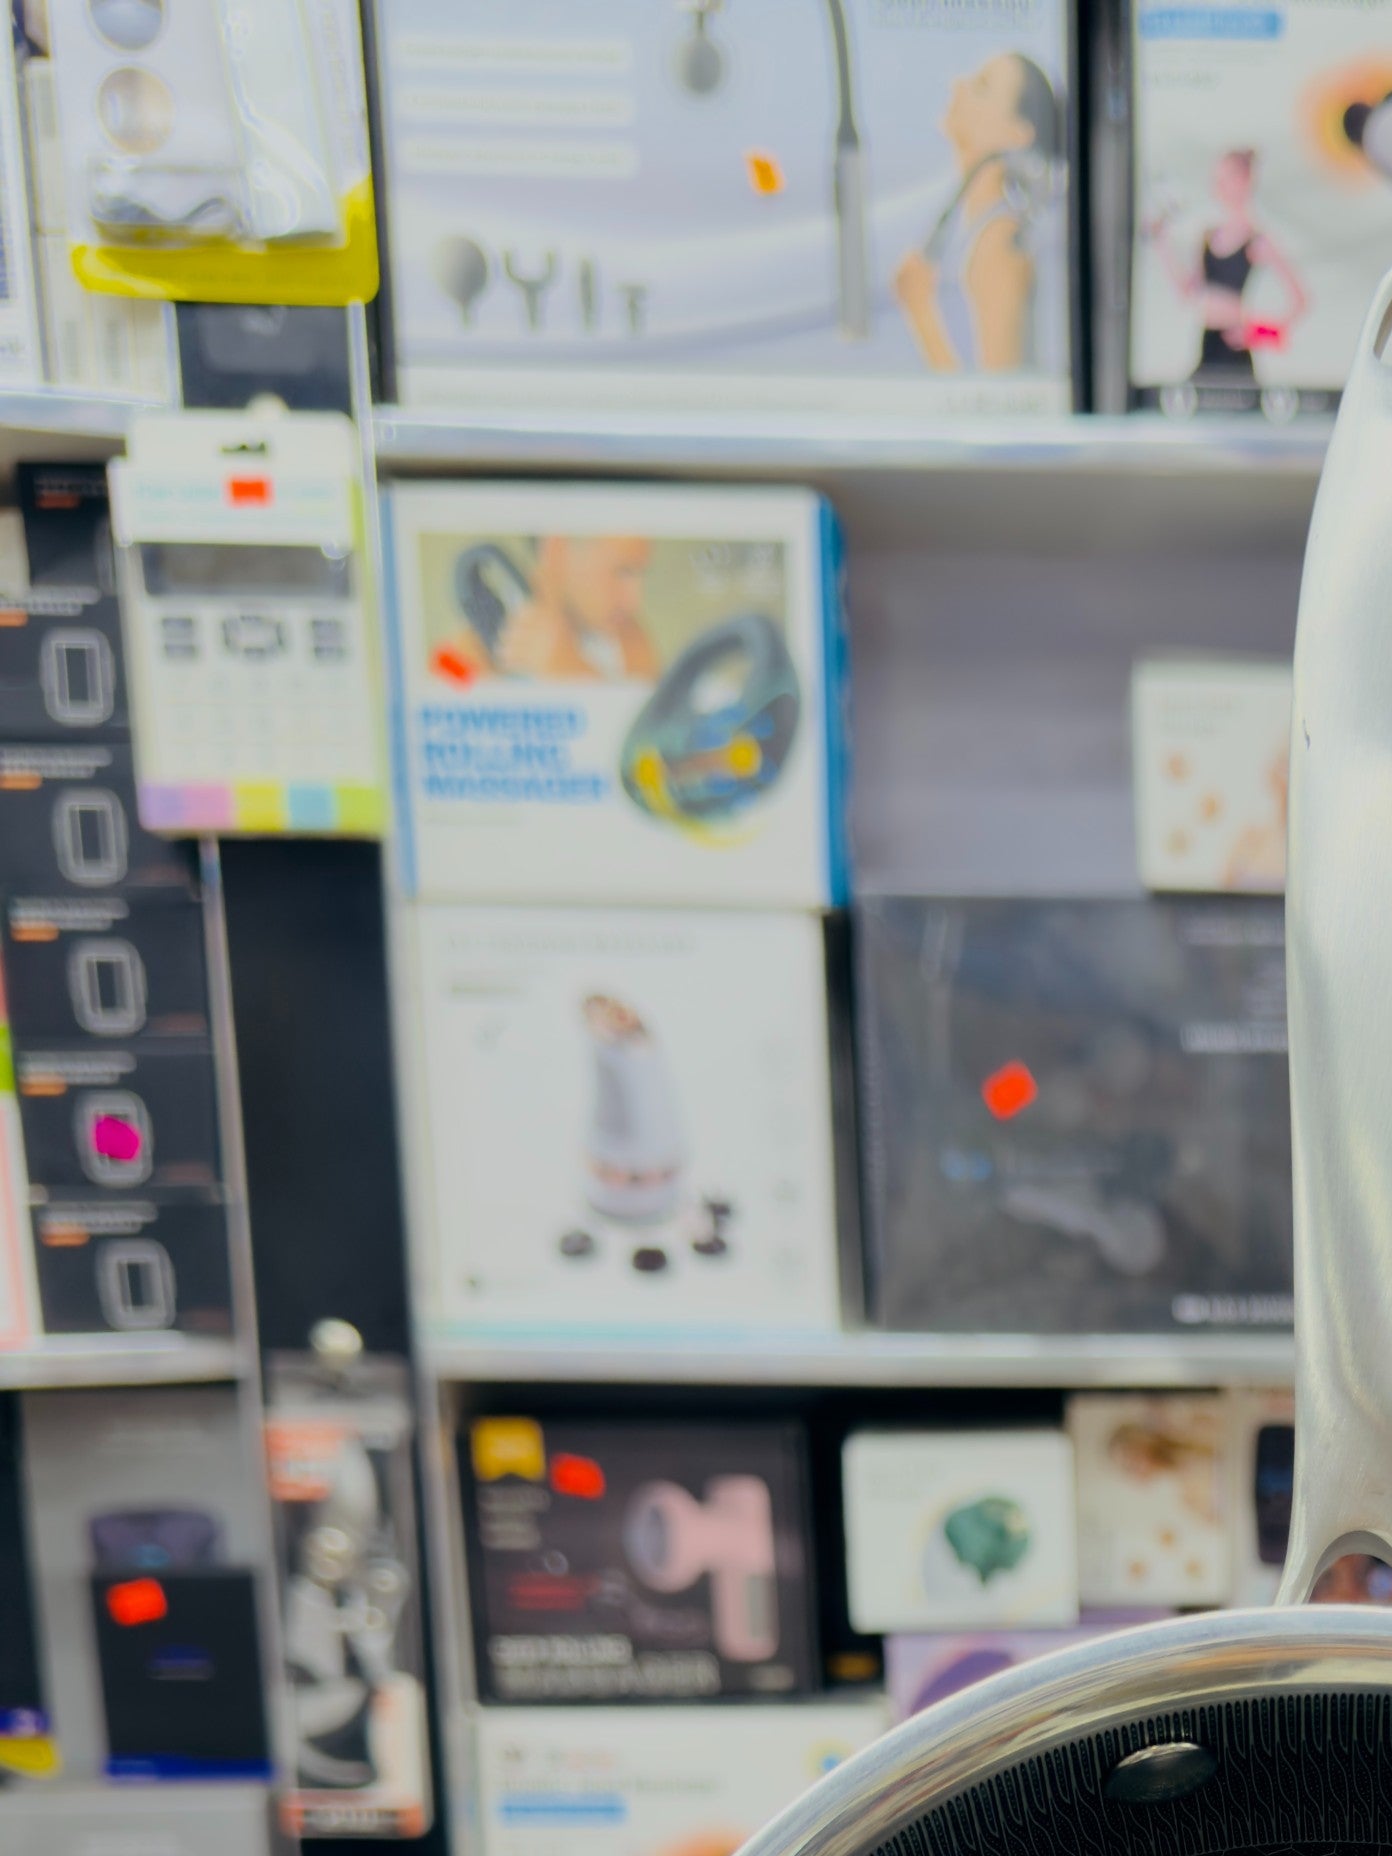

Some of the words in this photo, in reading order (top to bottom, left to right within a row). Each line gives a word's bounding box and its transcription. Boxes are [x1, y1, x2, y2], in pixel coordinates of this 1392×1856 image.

[421, 705, 585, 738] POWERED
[422, 742, 571, 772] ROLLING
[422, 773, 609, 802] MASSAGER
